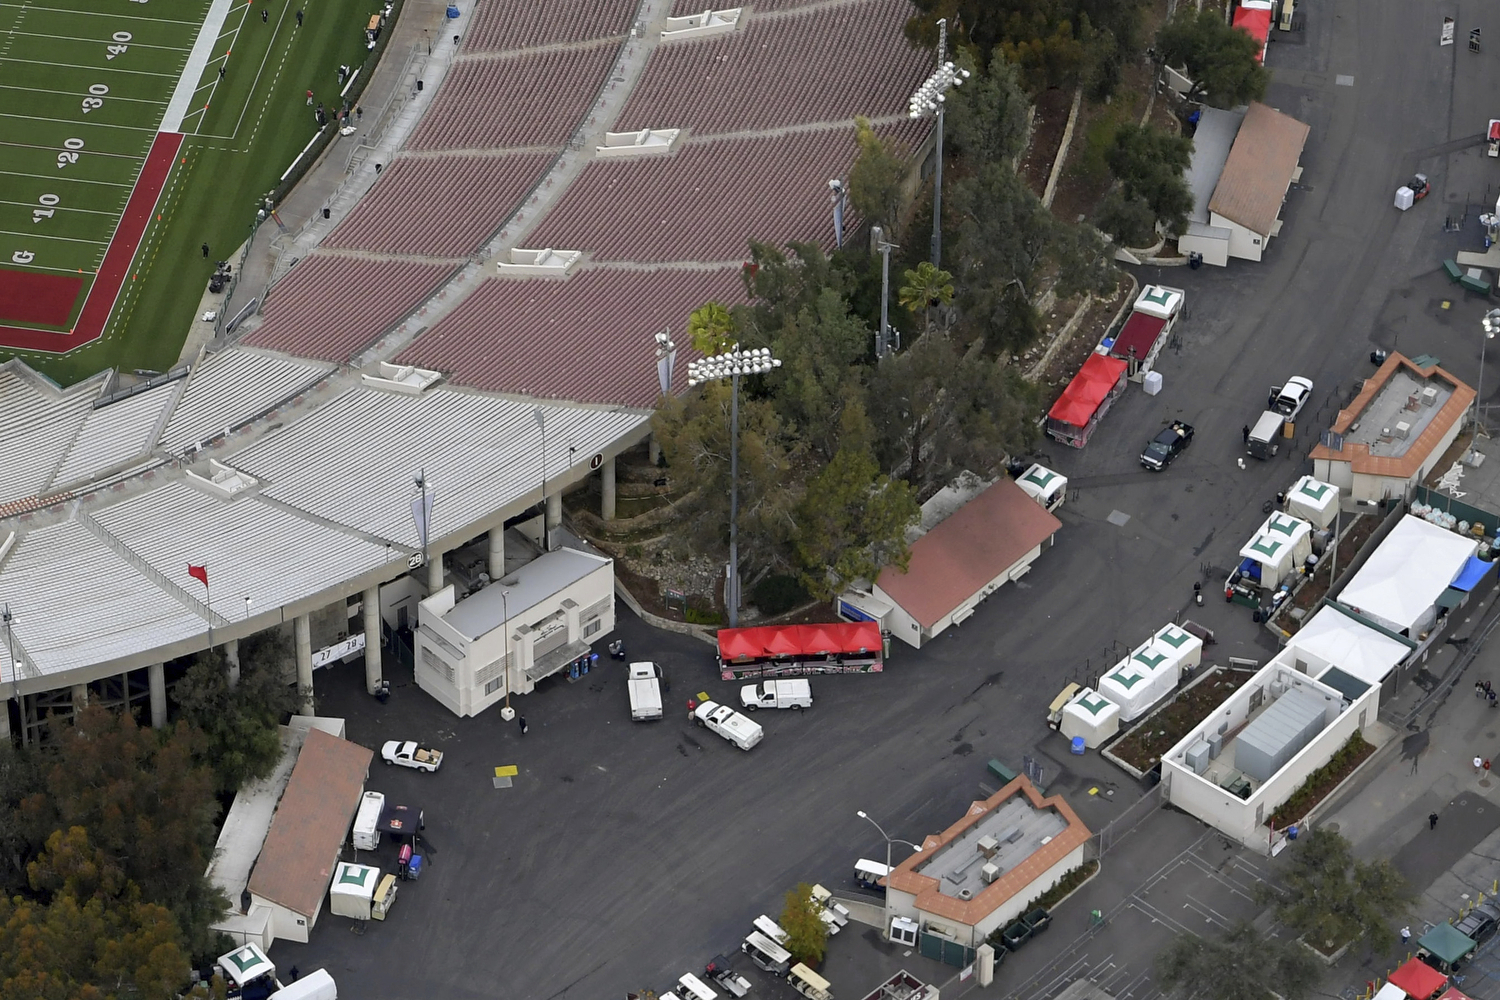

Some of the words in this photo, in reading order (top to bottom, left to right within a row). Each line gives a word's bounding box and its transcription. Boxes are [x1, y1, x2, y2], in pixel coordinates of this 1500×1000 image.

[107, 31, 132, 58] 40
[83, 83, 108, 110] 30
[57, 137, 84, 166] 20
[33, 194, 60, 221] 10
[12, 251, 34, 264] G
[409, 554, 422, 566] 28
[320, 650, 332, 661] 27
[346, 638, 357, 650] 28
